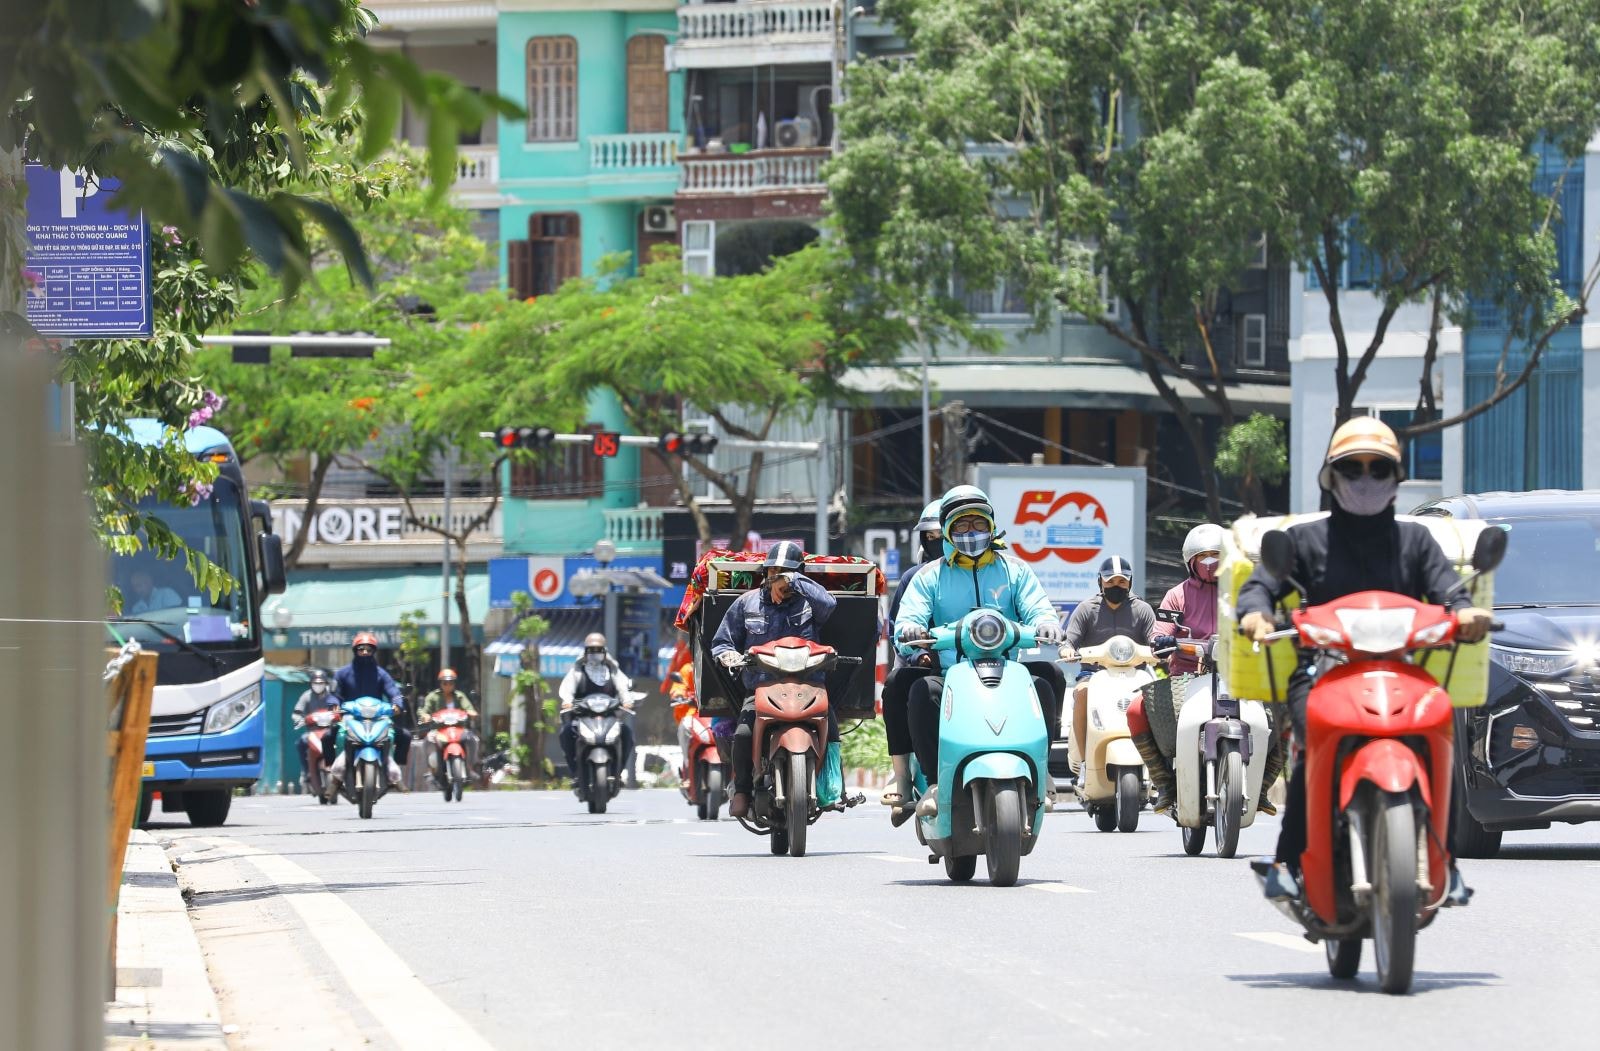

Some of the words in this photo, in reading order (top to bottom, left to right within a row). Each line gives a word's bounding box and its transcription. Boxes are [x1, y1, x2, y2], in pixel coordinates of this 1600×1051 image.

[60, 164, 100, 217] P
[86, 232, 104, 240] NGỌC
[270, 506, 401, 545] MORE
